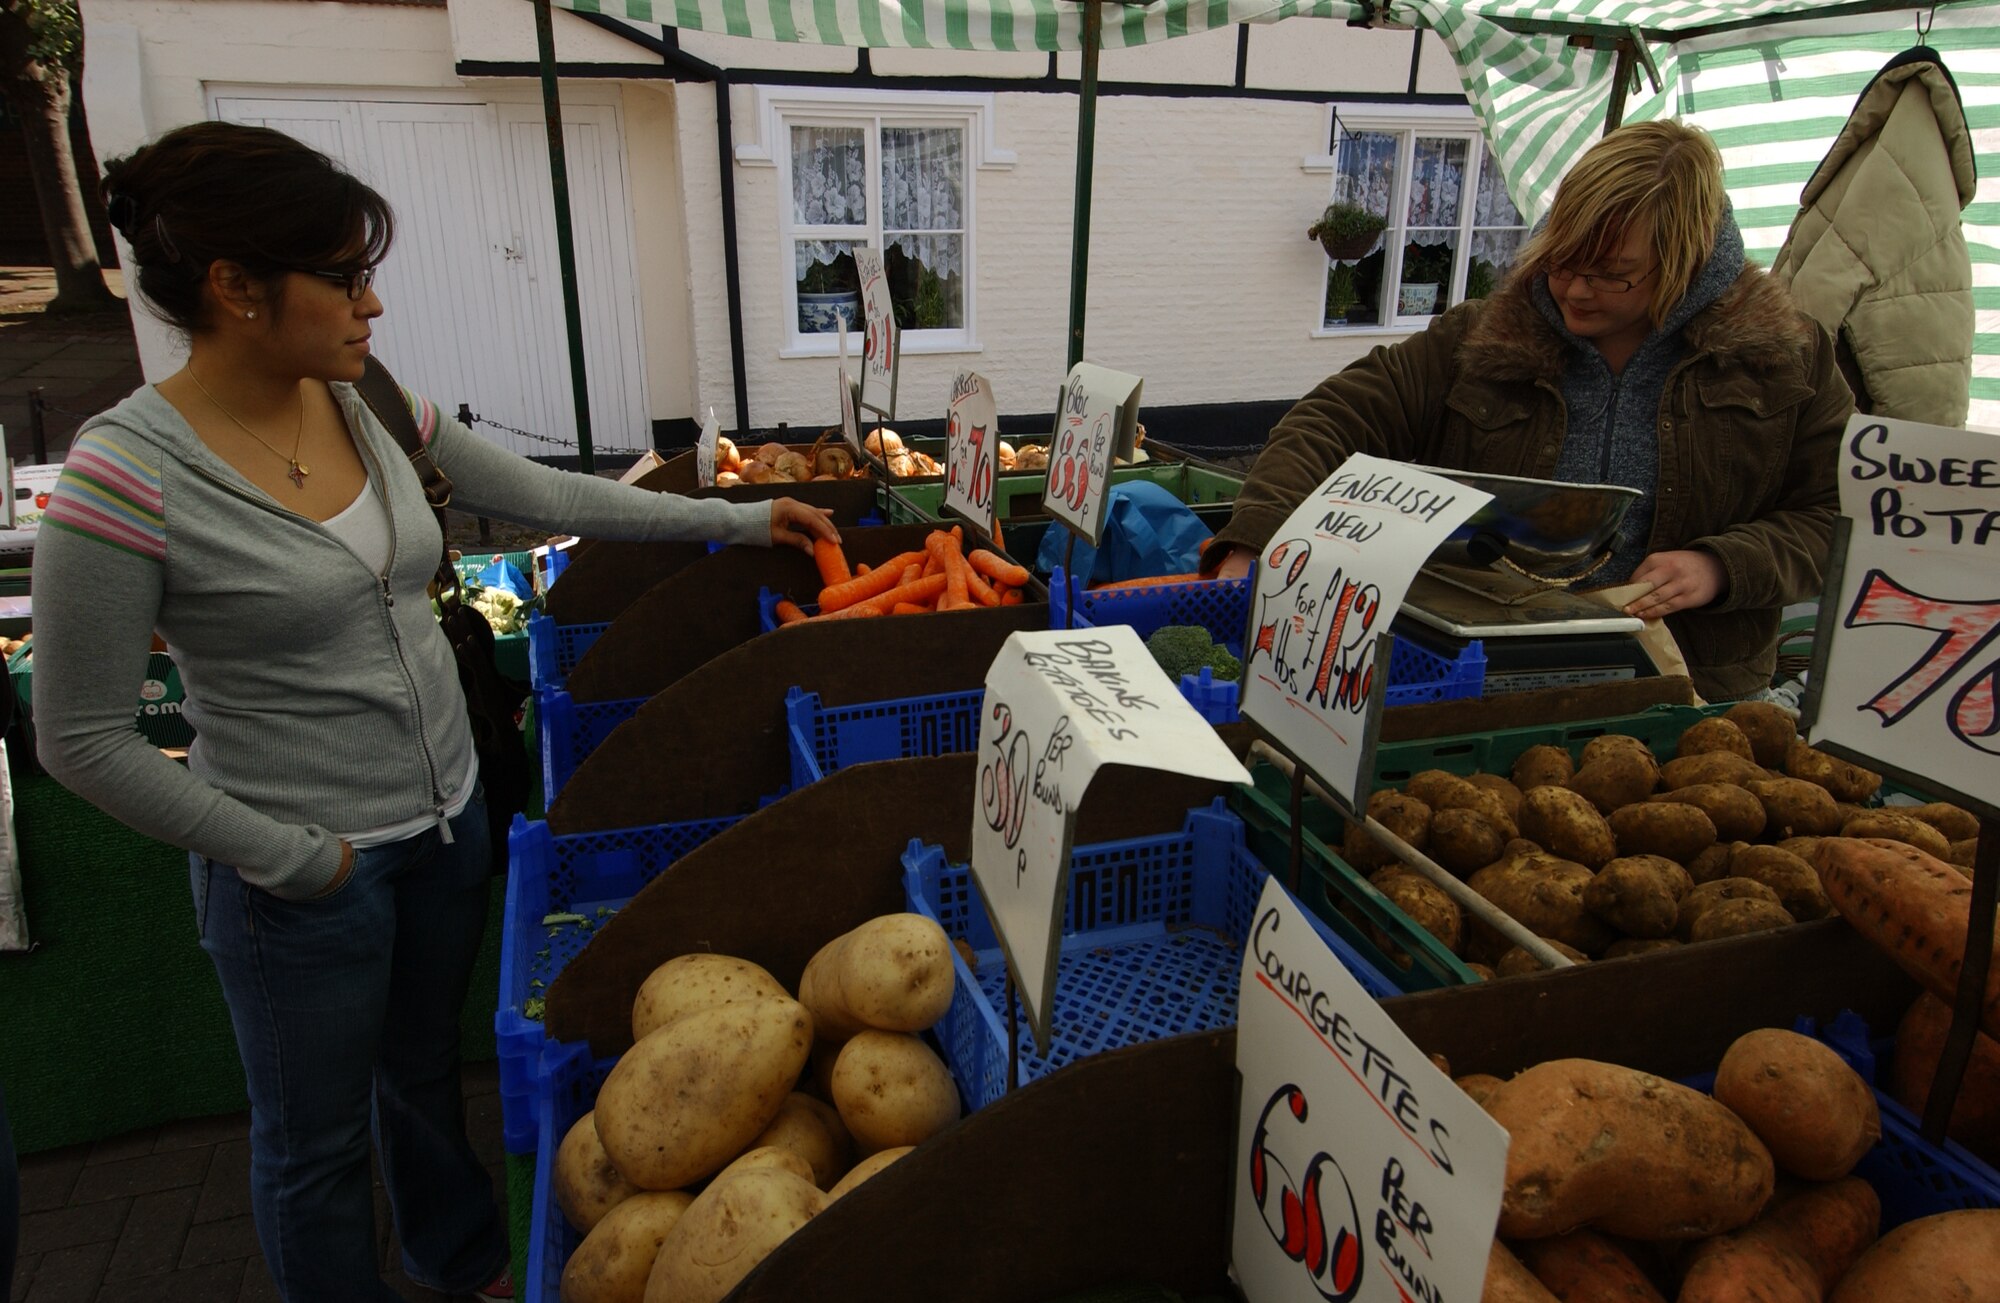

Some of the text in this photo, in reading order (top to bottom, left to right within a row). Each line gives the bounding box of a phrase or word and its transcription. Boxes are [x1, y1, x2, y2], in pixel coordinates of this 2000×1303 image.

[1315, 510, 1383, 543] NEW
[1321, 473, 1456, 523] ENGLISH
[1023, 651, 1139, 741] POTATOES
[1054, 639, 1160, 711] BAKING
[1253, 907, 1455, 1176] COURGETTES
[1250, 1083, 1365, 1303] 60
[1381, 1157, 1433, 1260] PER
[1375, 1208, 1446, 1303] POUN
